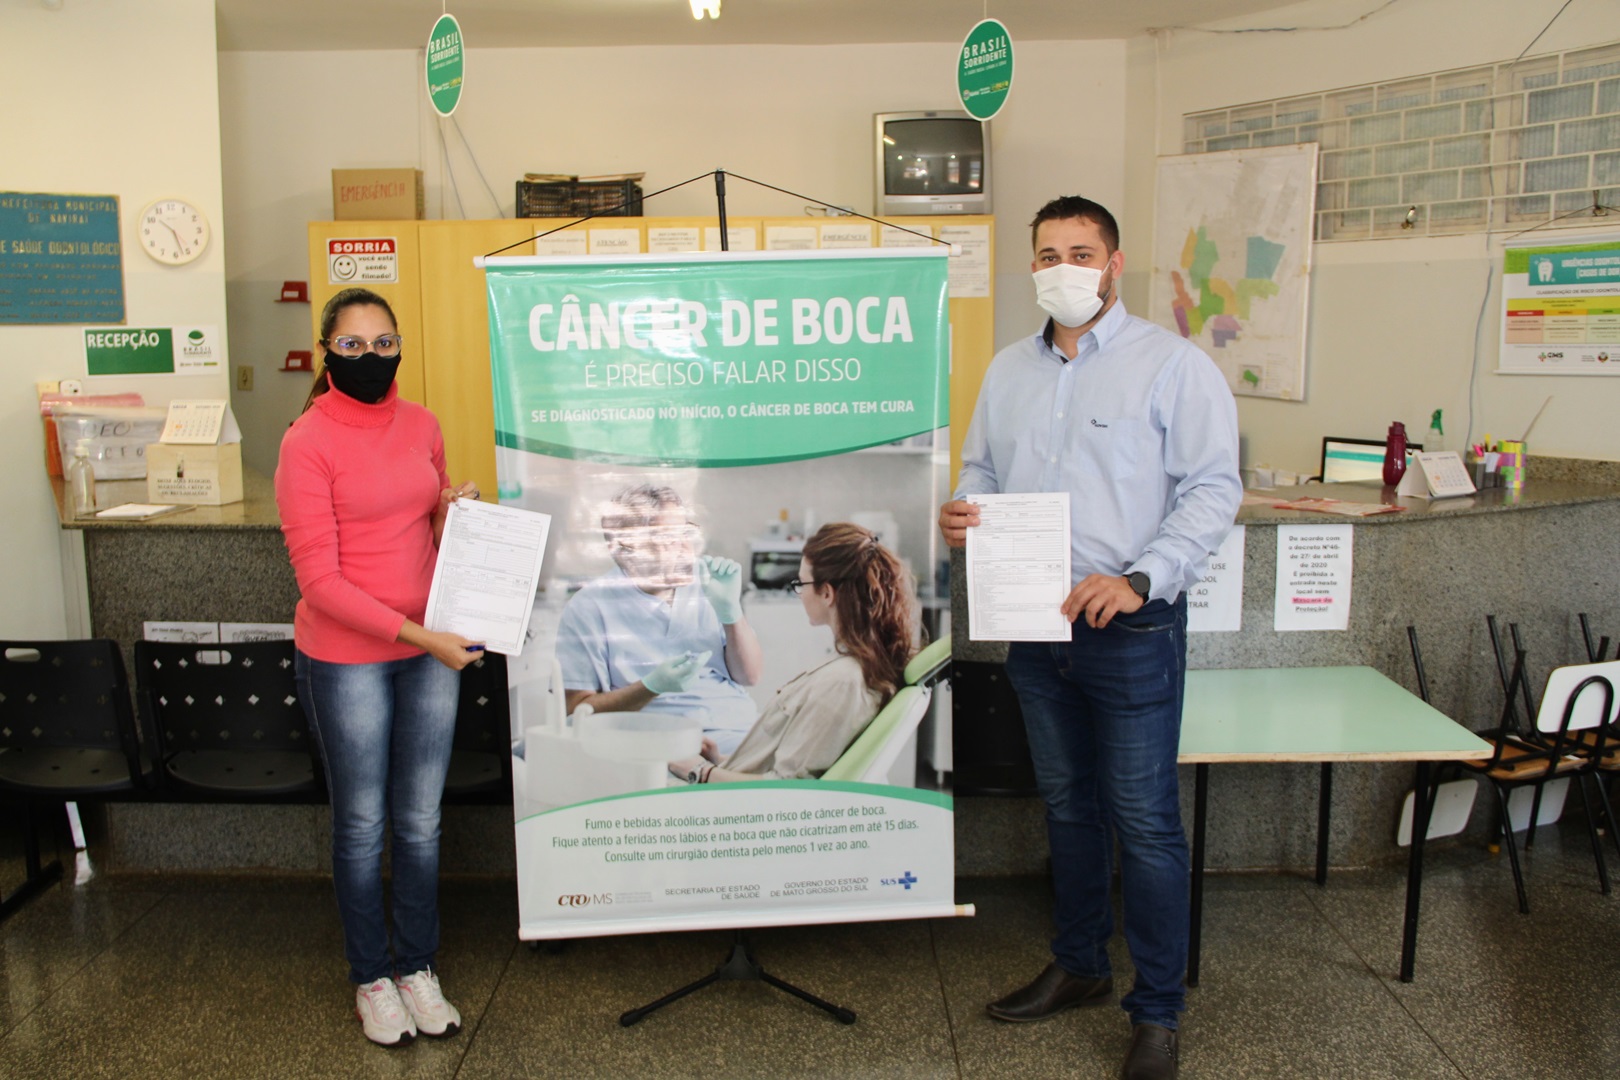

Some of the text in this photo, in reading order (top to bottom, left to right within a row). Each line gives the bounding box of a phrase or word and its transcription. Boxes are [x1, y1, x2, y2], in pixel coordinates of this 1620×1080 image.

[430, 32, 459, 54] BRASIL
[964, 36, 1006, 58] BRASIL
[431, 45, 459, 64] SORRIDENTE
[964, 48, 1006, 69] SORRIDENTE
[66, 200, 117, 212] MUNICIPAL
[0, 240, 6, 254] E
[12, 239, 43, 254] SAÚDE
[334, 242, 390, 252] SORRIA
[528, 294, 914, 352] CÂNCER DE BOCA
[87, 330, 160, 350] RECEPÇÃO
[585, 358, 861, 388] É PRECISO FALAR DISSO
[531, 400, 914, 423] SE DIAGNOSTICADO NO INÍCIO, O CÂNCER DE BOCA TEM CURA
[585, 805, 887, 830] Fumo e bebidas alcoólicas aumentam o risco de câncer de boca.
[552, 818, 920, 848] Fique atento a feridas nos lábios e na boca que não cicatrizam em até 15 dias.
[604, 840, 870, 862] Consulte um cirurgião dentista pelo menos 1 vez ao ano.
[665, 887, 714, 896] SECRETARIA
[728, 884, 760, 892] ESTADO
[770, 890, 782, 898] DE
[783, 888, 804, 896] MATO
[806, 886, 839, 894] GROSSO
[784, 880, 823, 889] GOVERNO
[838, 877, 868, 886] ESTADO
[880, 878, 896, 886] SUS
[593, 893, 613, 904] MS
